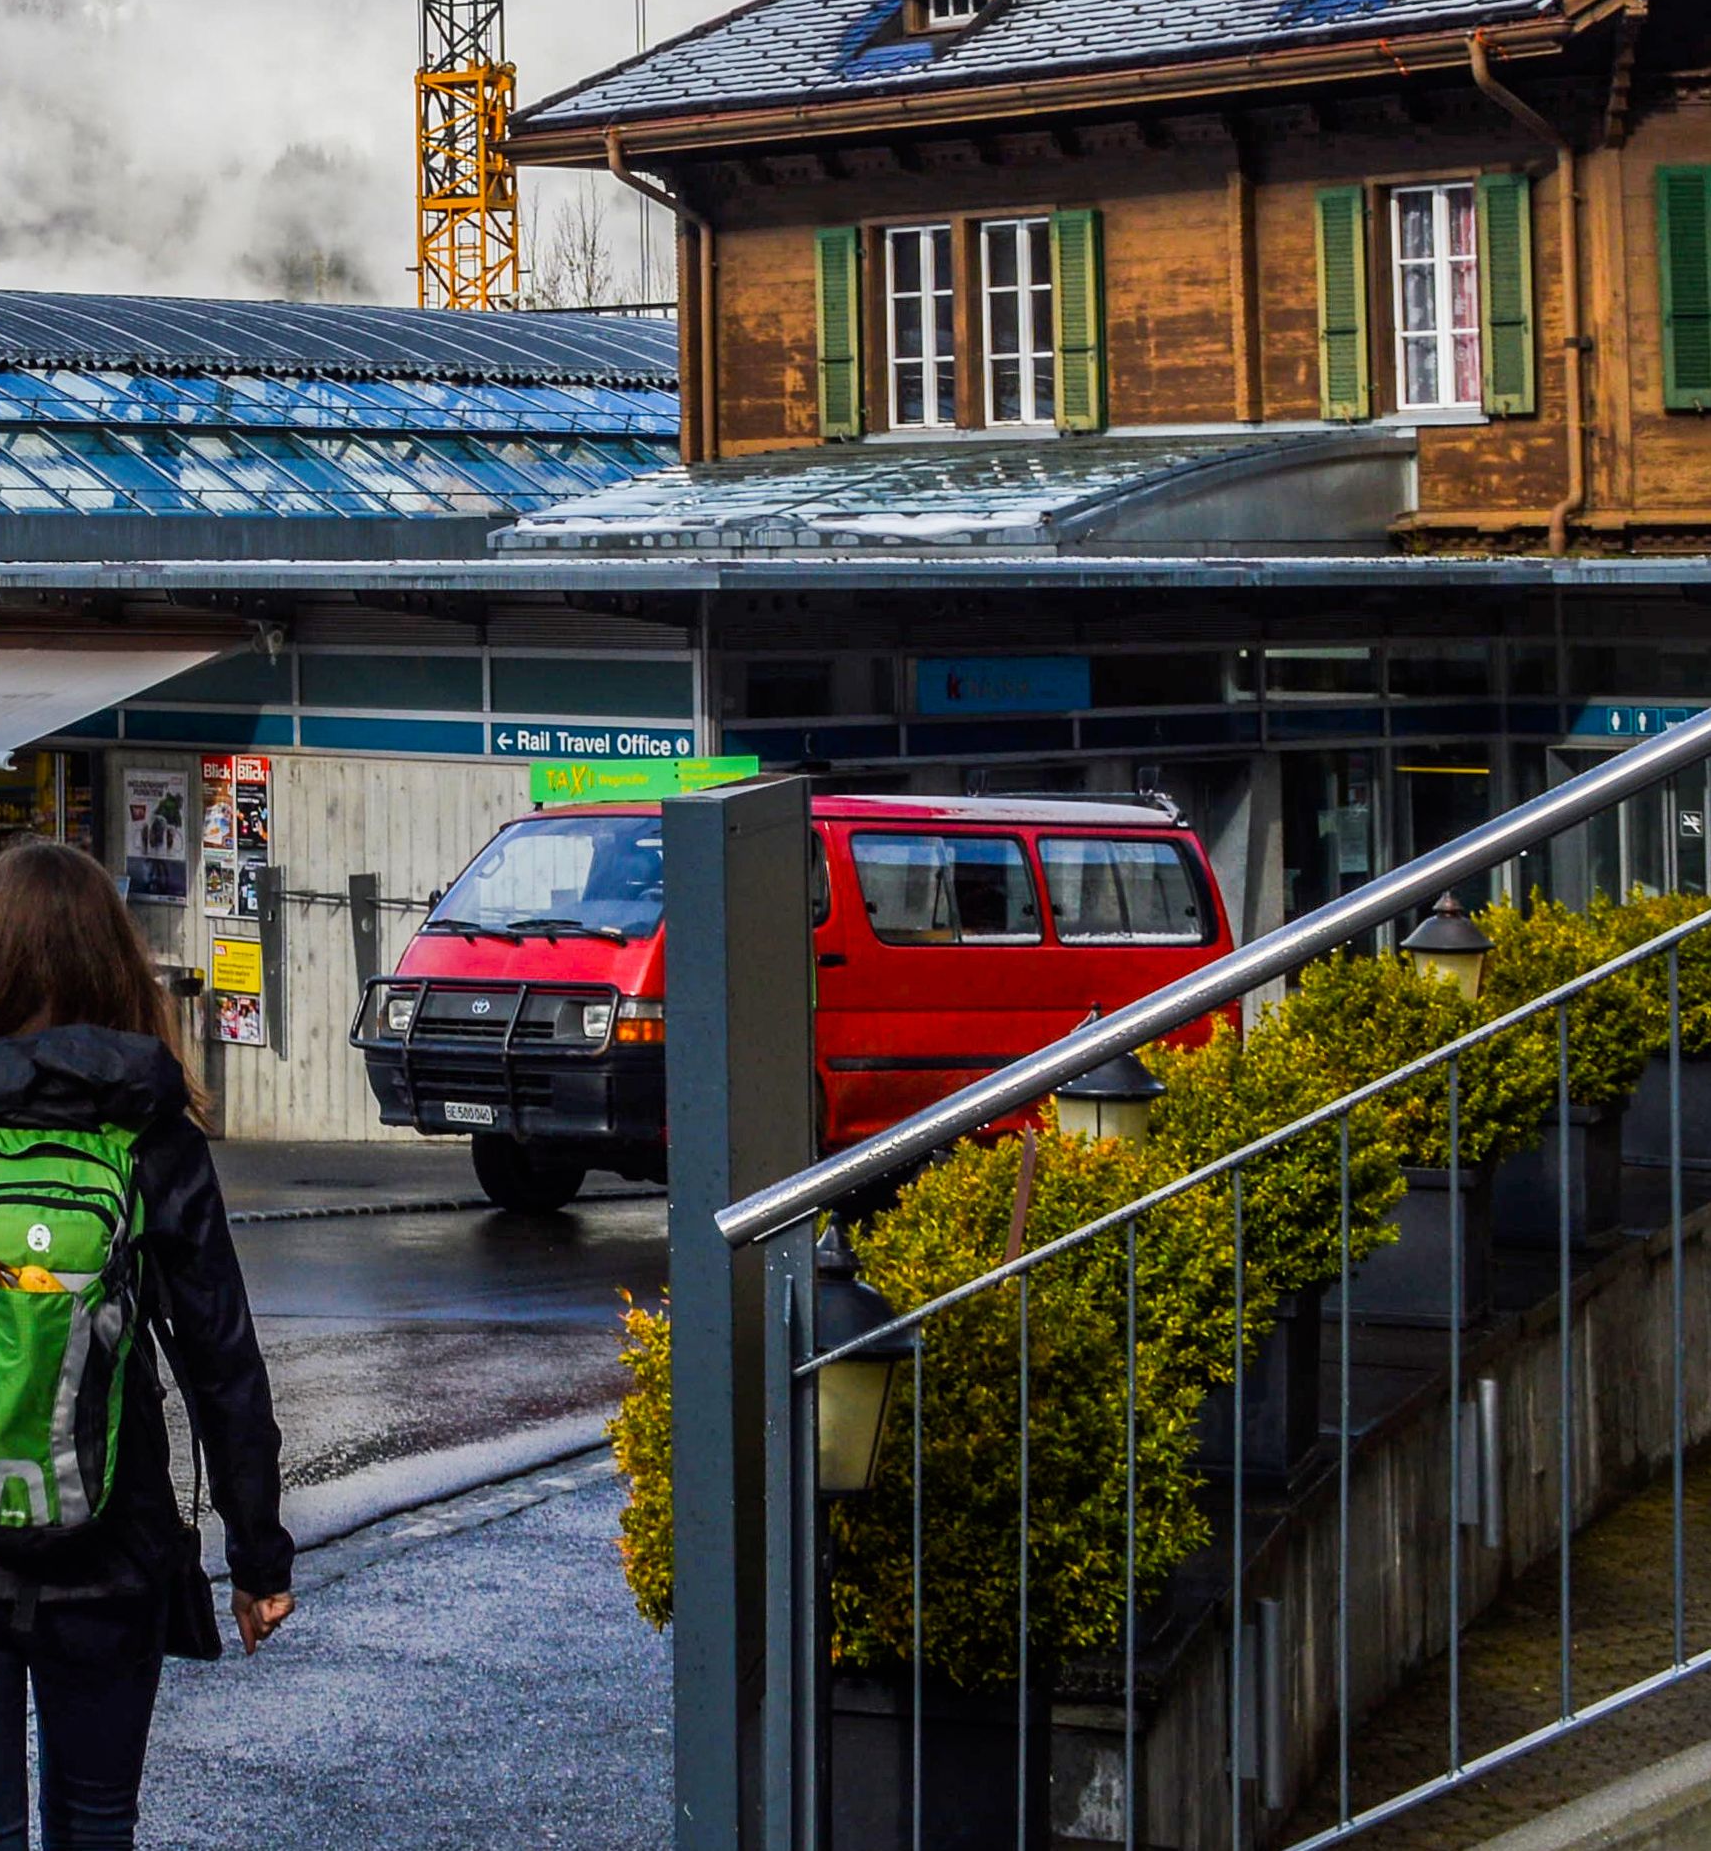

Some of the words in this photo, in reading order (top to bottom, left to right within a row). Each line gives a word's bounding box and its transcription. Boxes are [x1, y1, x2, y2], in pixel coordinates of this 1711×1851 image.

[517, 730, 551, 751] Rail
[556, 731, 610, 754] Travel
[617, 733, 672, 757] Office
[203, 763, 231, 780] Blick
[237, 764, 266, 781] Blick
[545, 763, 595, 797] TAXI
